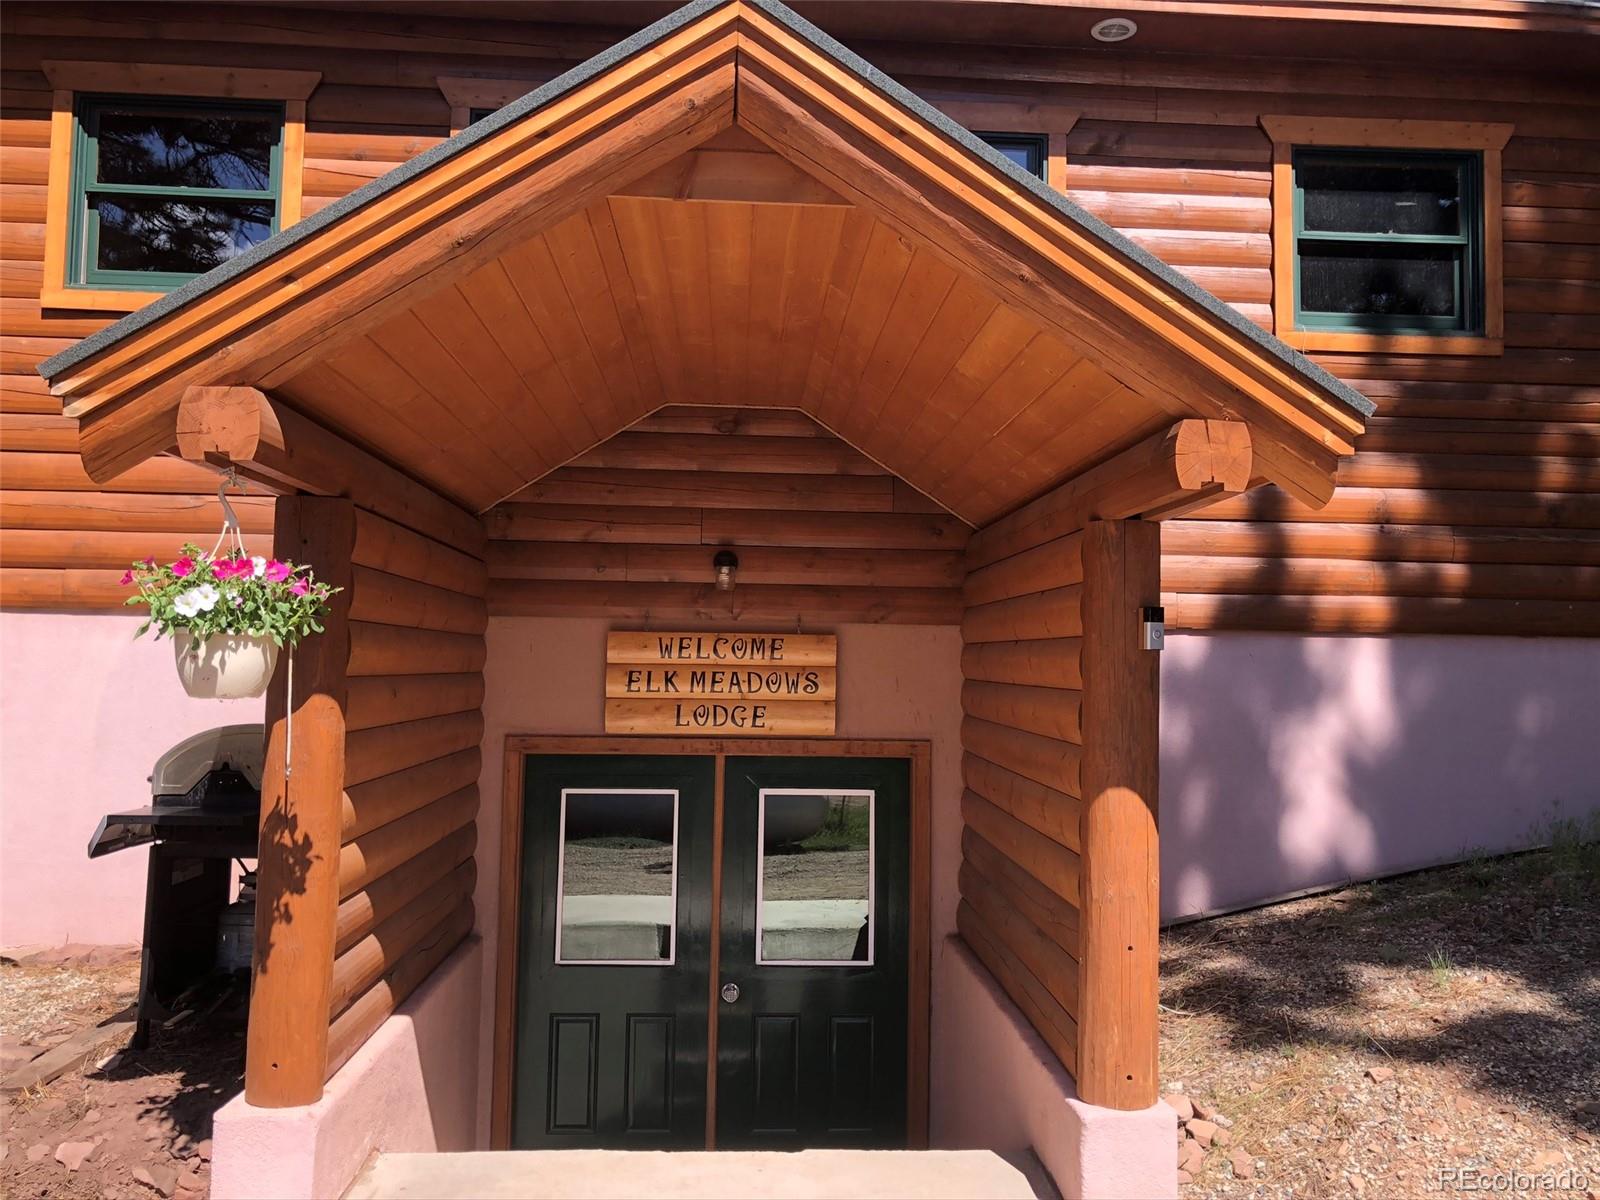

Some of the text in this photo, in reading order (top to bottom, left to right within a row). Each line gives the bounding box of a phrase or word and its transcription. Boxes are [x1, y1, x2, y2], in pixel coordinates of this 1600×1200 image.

[657, 636, 785, 661] WELCOME
[626, 670, 820, 694] ELK MEADOWS
[675, 704, 767, 728] LODGE
